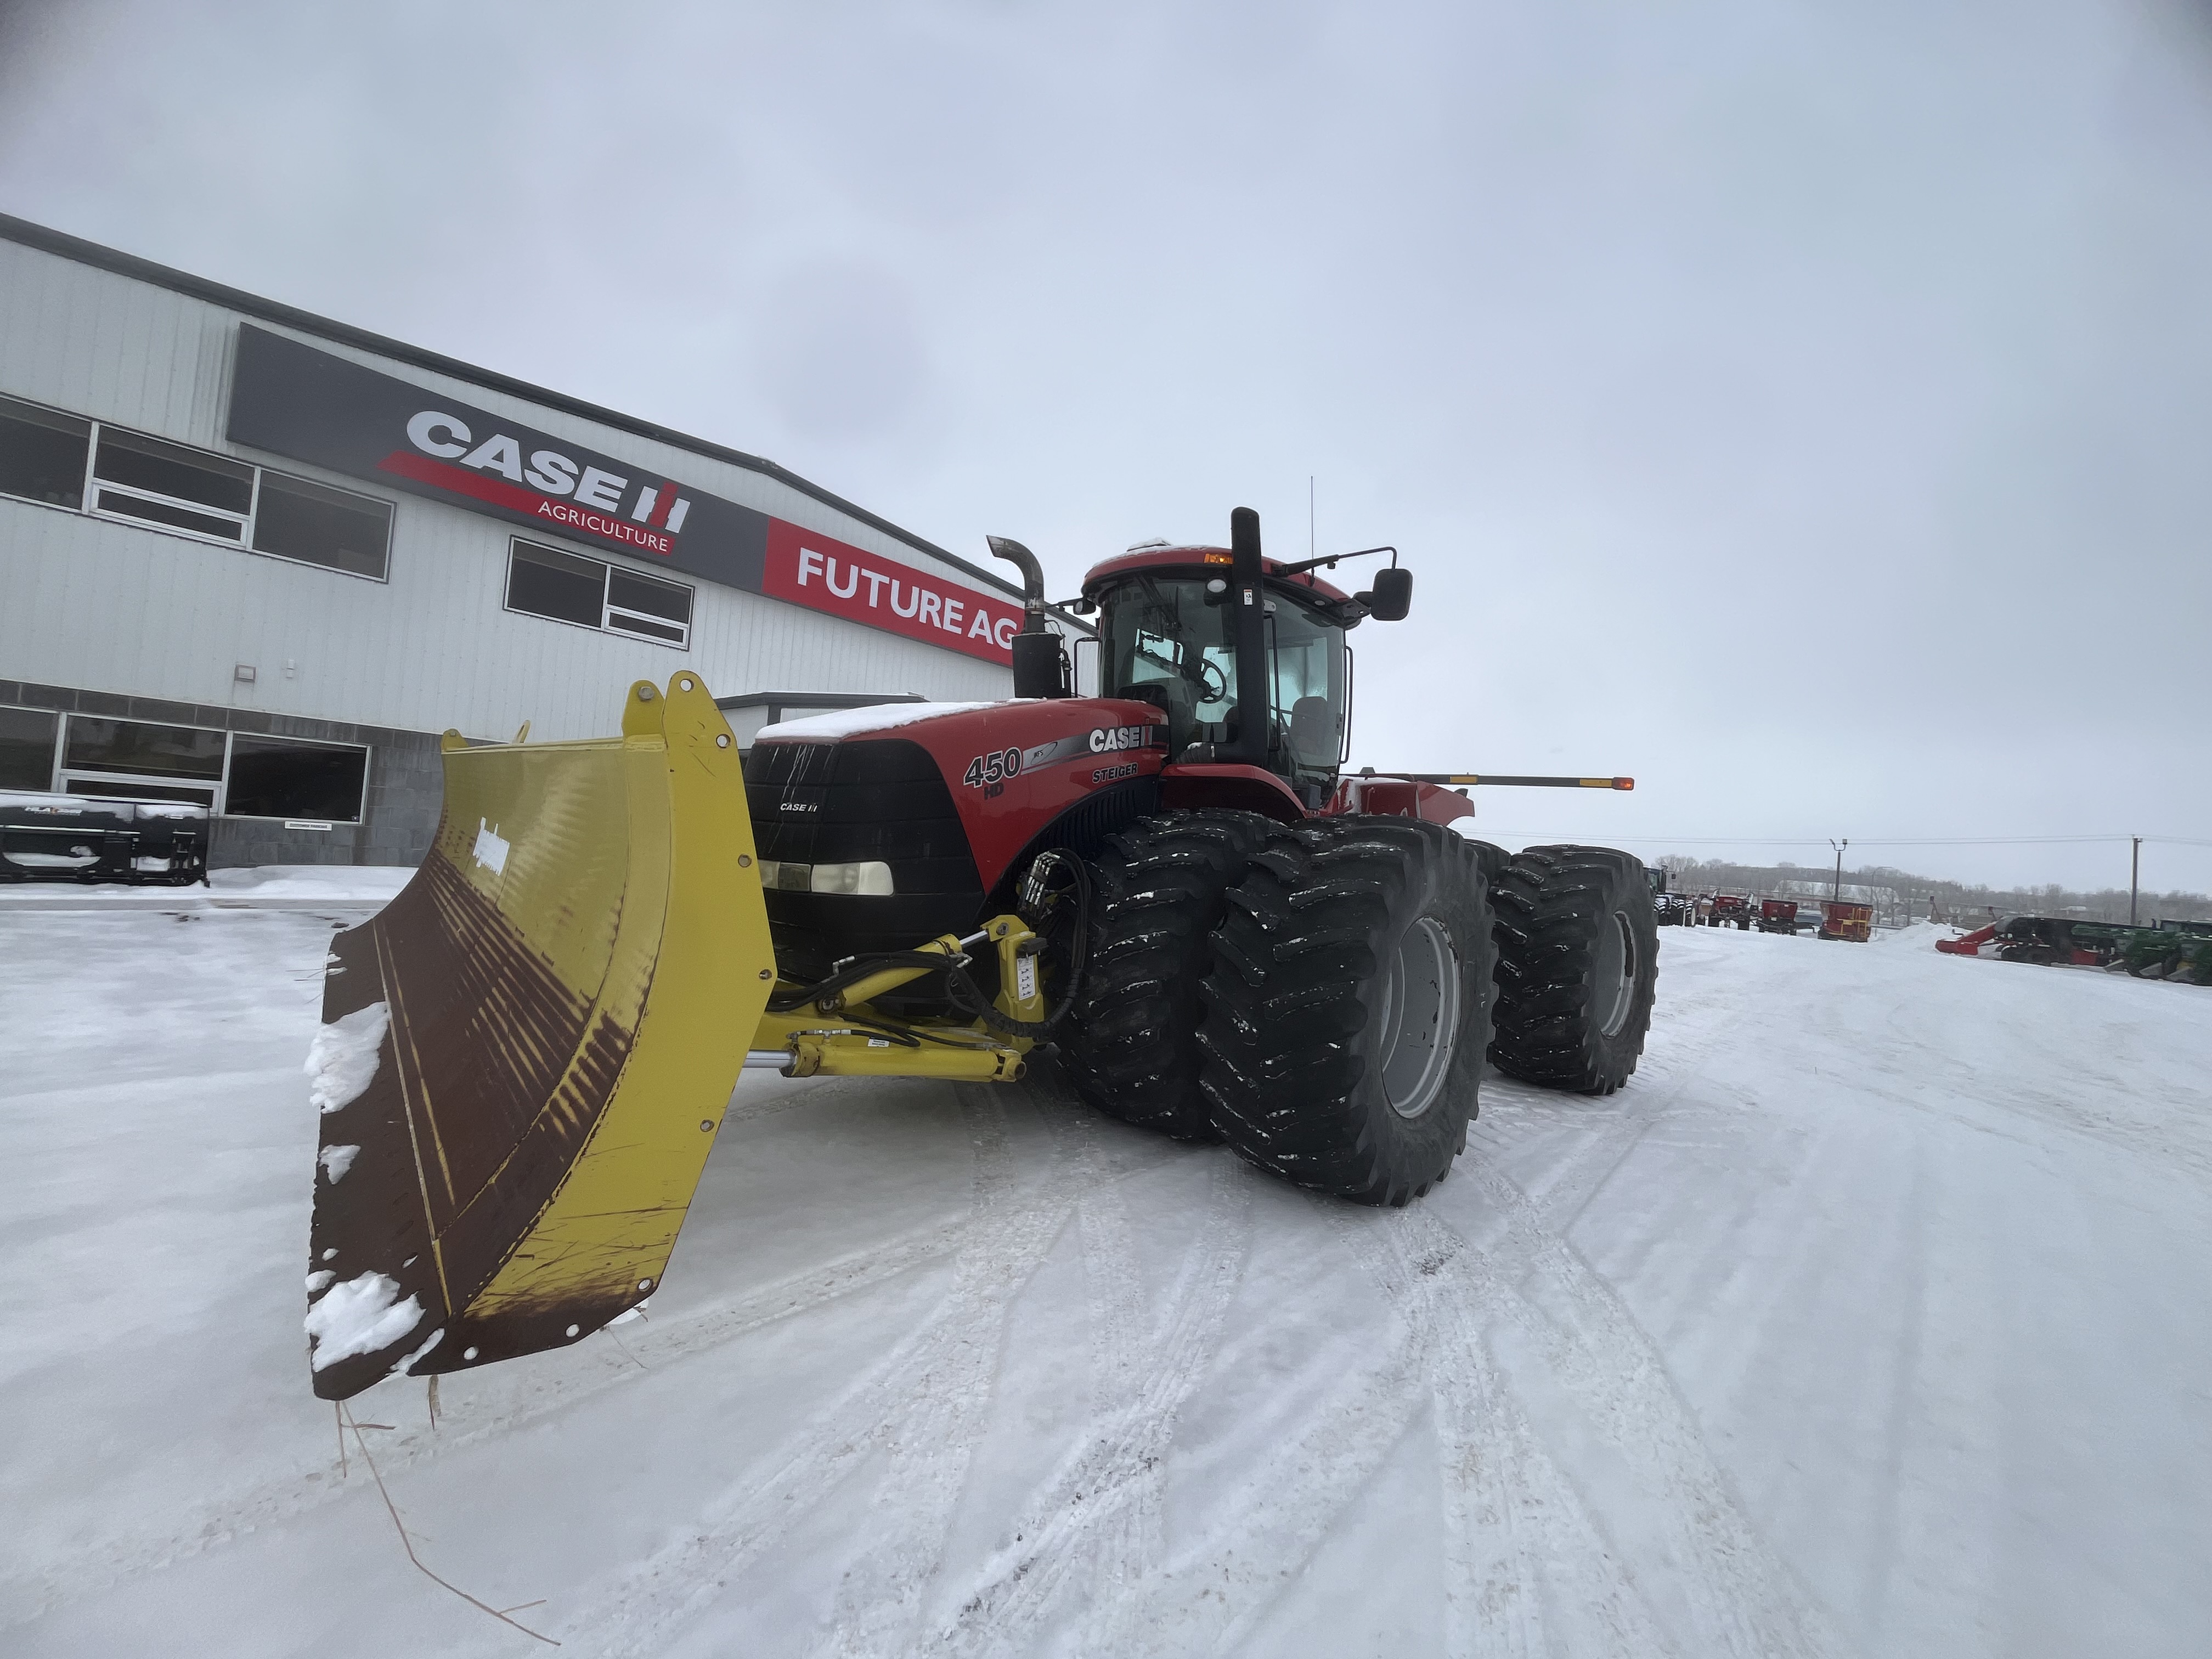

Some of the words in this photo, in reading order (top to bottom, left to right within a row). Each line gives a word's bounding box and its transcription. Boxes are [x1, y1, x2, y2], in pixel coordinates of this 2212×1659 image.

[407, 410, 628, 512] CASE
[538, 501, 668, 552] AGRICULTURE
[797, 547, 964, 635] FUTURE
[967, 609, 1017, 650] AG
[1090, 726, 1139, 753] CASE
[963, 747, 1022, 788] 450
[1092, 762, 1138, 783] STEIGER
[780, 803, 807, 812] CASE
[984, 782, 1004, 800] HD
